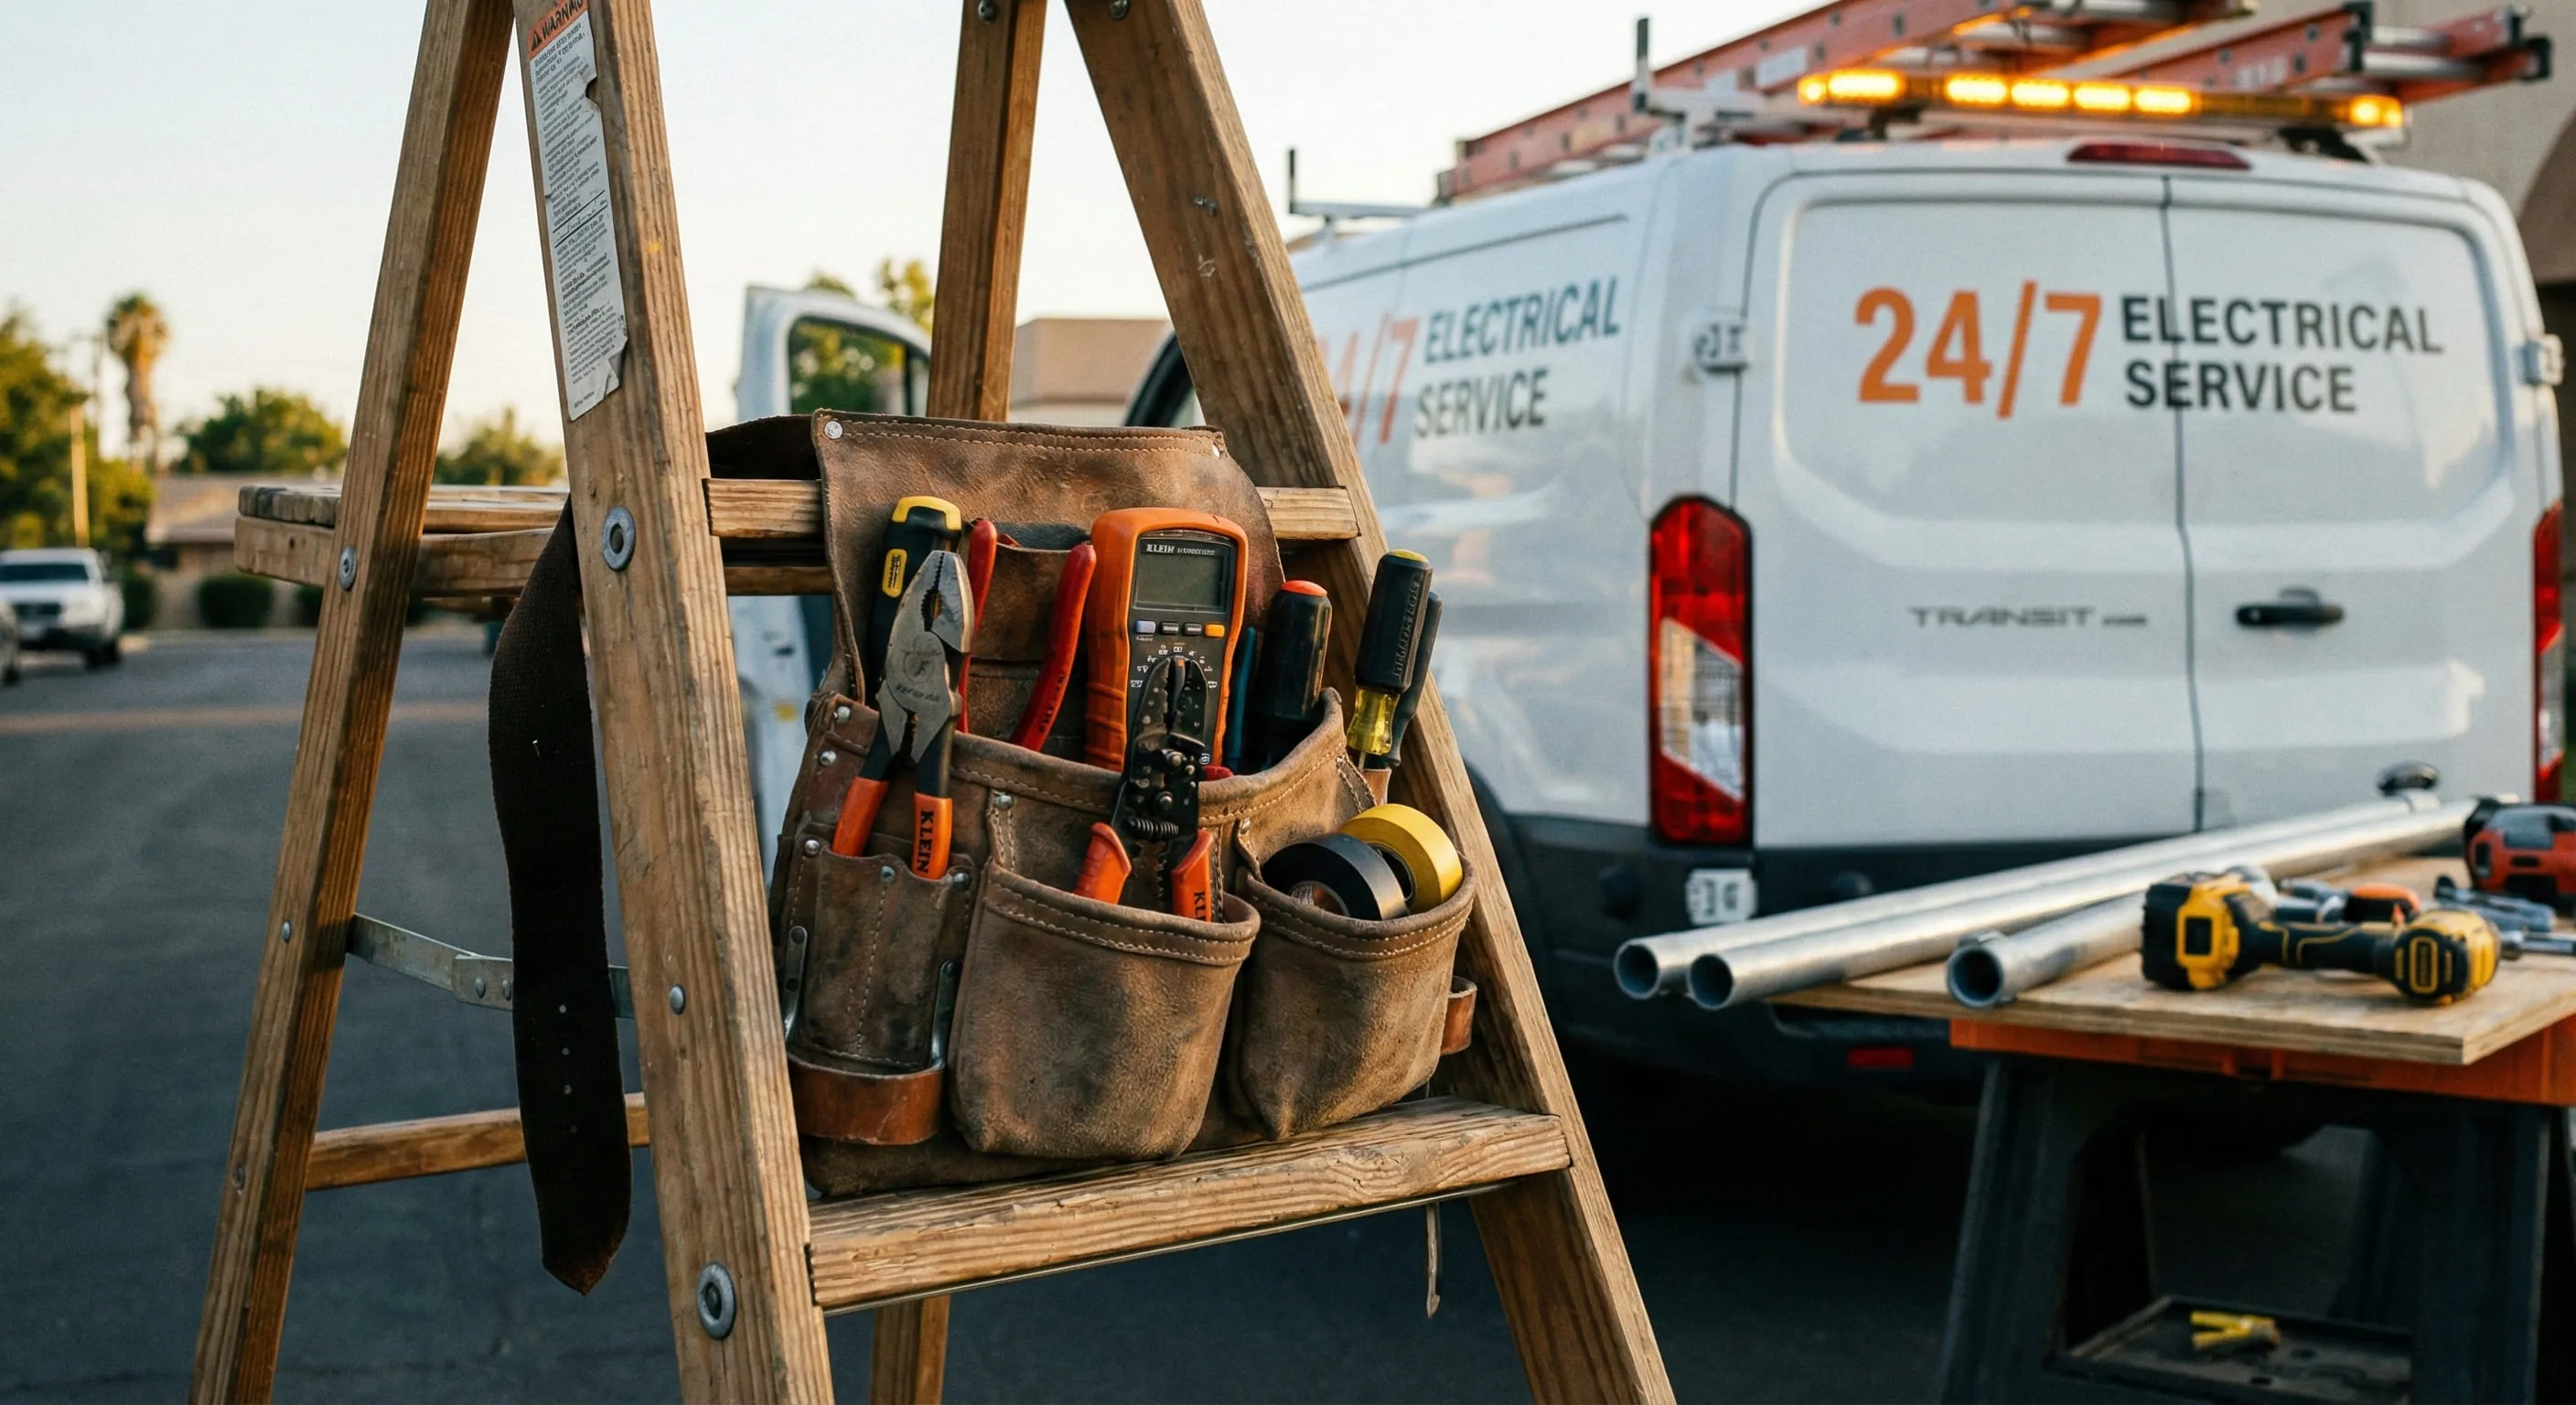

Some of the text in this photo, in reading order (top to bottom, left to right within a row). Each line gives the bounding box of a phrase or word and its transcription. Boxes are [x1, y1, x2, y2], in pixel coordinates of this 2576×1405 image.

[1317, 276, 1620, 449] 4/7 ELECTRICAL
[1854, 281, 2443, 419] 24/7 ELECTRICAL
[1415, 368, 1549, 437] SERVICE
[2125, 360, 2356, 413] SERVICE
[1908, 606, 2097, 627] TRANSIT
[918, 810, 934, 874] KLEIN
